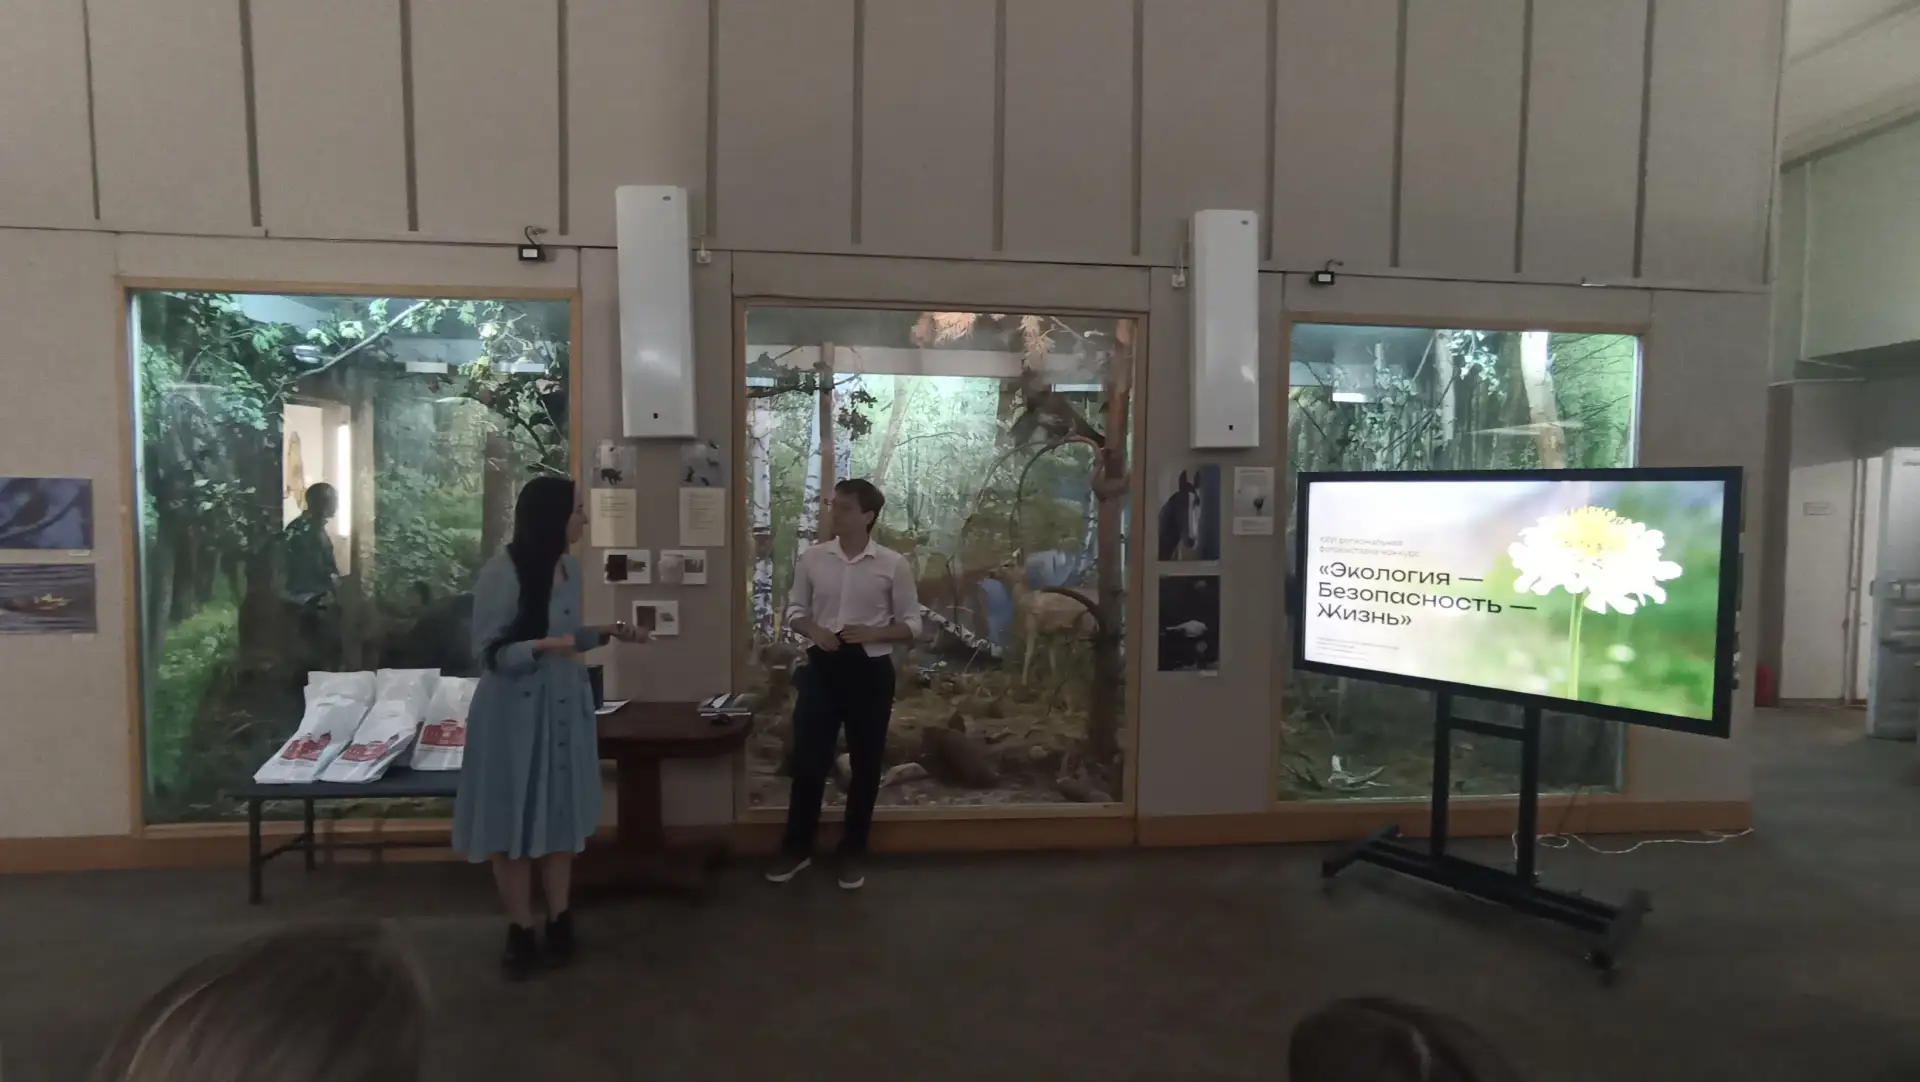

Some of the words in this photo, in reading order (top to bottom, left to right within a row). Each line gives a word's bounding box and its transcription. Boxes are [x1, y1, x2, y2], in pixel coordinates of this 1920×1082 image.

[1319, 561, 1451, 586] «Экология
[1318, 581, 1502, 614] Безопасность
[1317, 602, 1412, 626] Жизнь»
